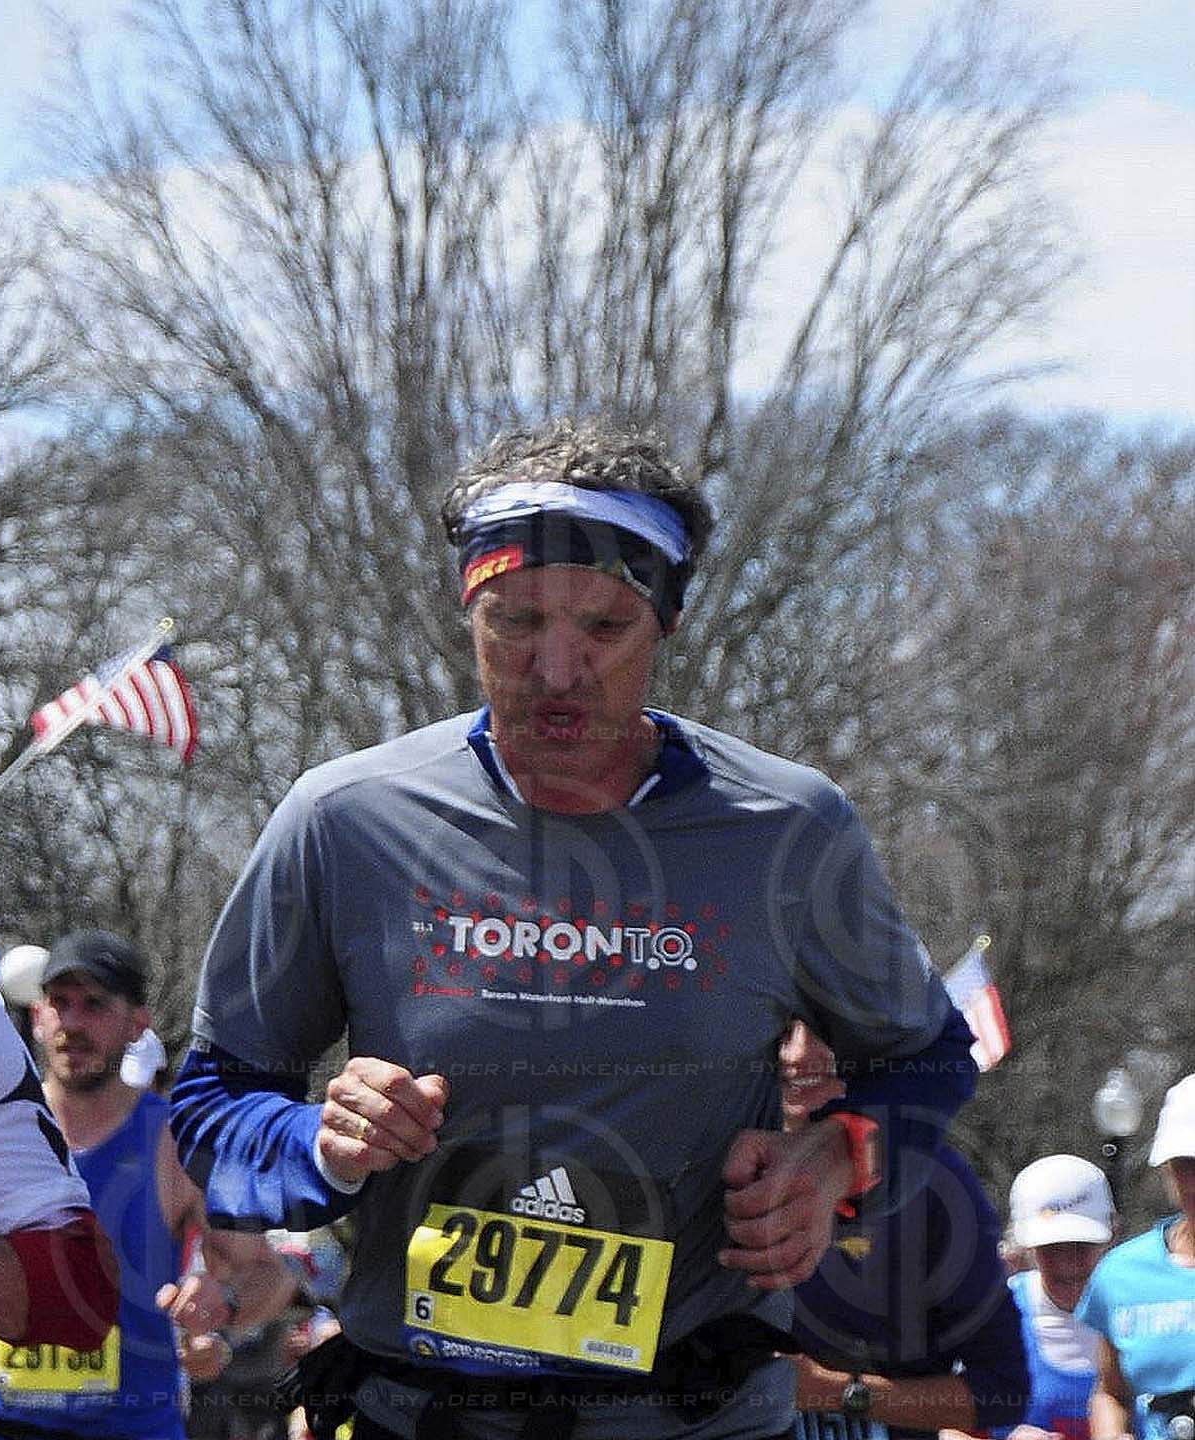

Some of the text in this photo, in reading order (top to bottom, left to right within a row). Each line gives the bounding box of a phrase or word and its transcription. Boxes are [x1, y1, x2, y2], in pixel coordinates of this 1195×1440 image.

[510, 1196, 586, 1225] adidas
[428, 1211, 644, 1327] 29774
[414, 1296, 431, 1321] 6
